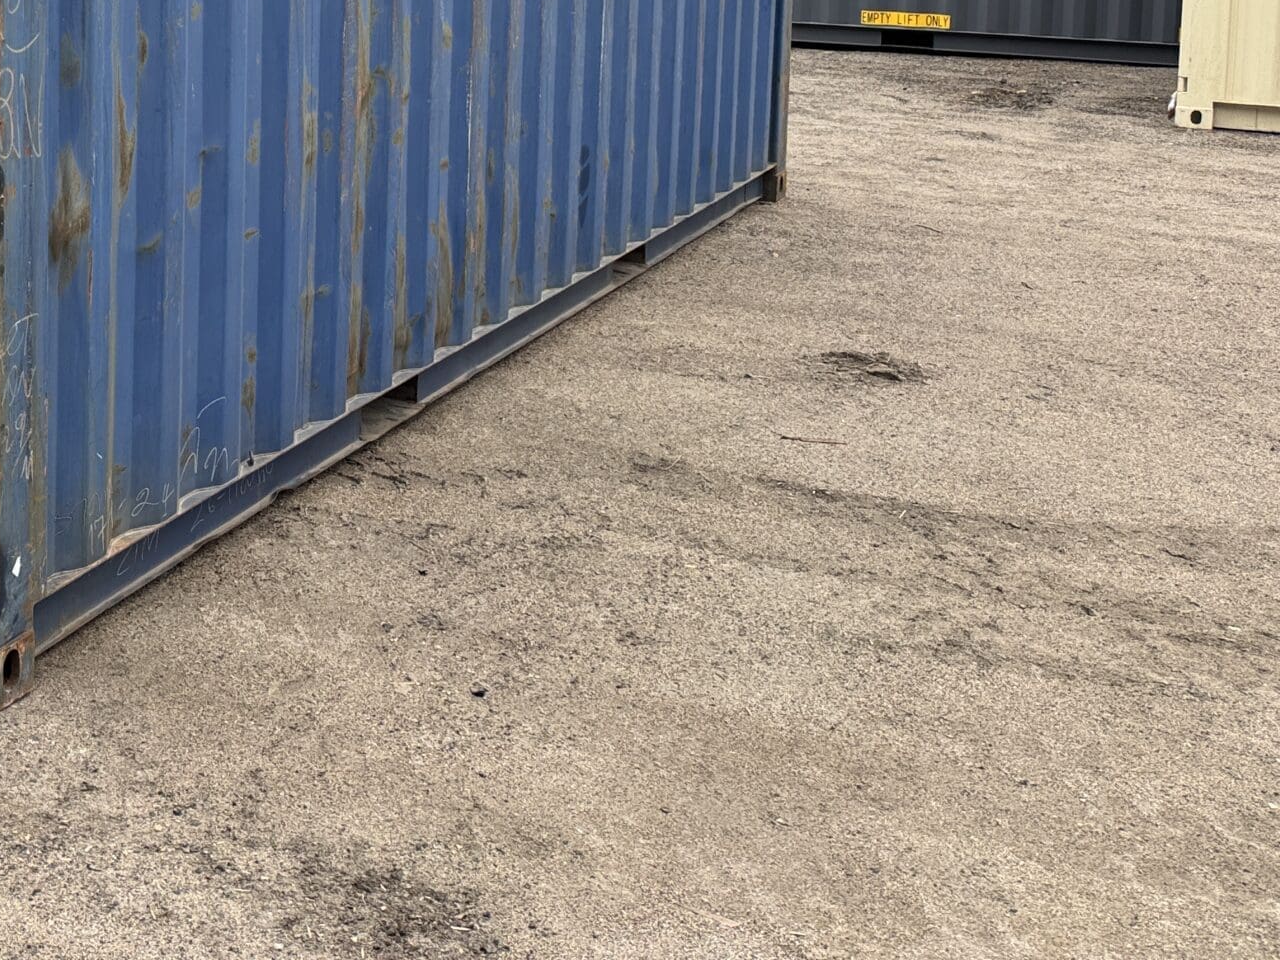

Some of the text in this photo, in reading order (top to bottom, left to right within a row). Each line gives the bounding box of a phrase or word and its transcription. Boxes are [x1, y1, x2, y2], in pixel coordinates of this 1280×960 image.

[862, 11, 949, 27] EMPTY LIFT ONLY
